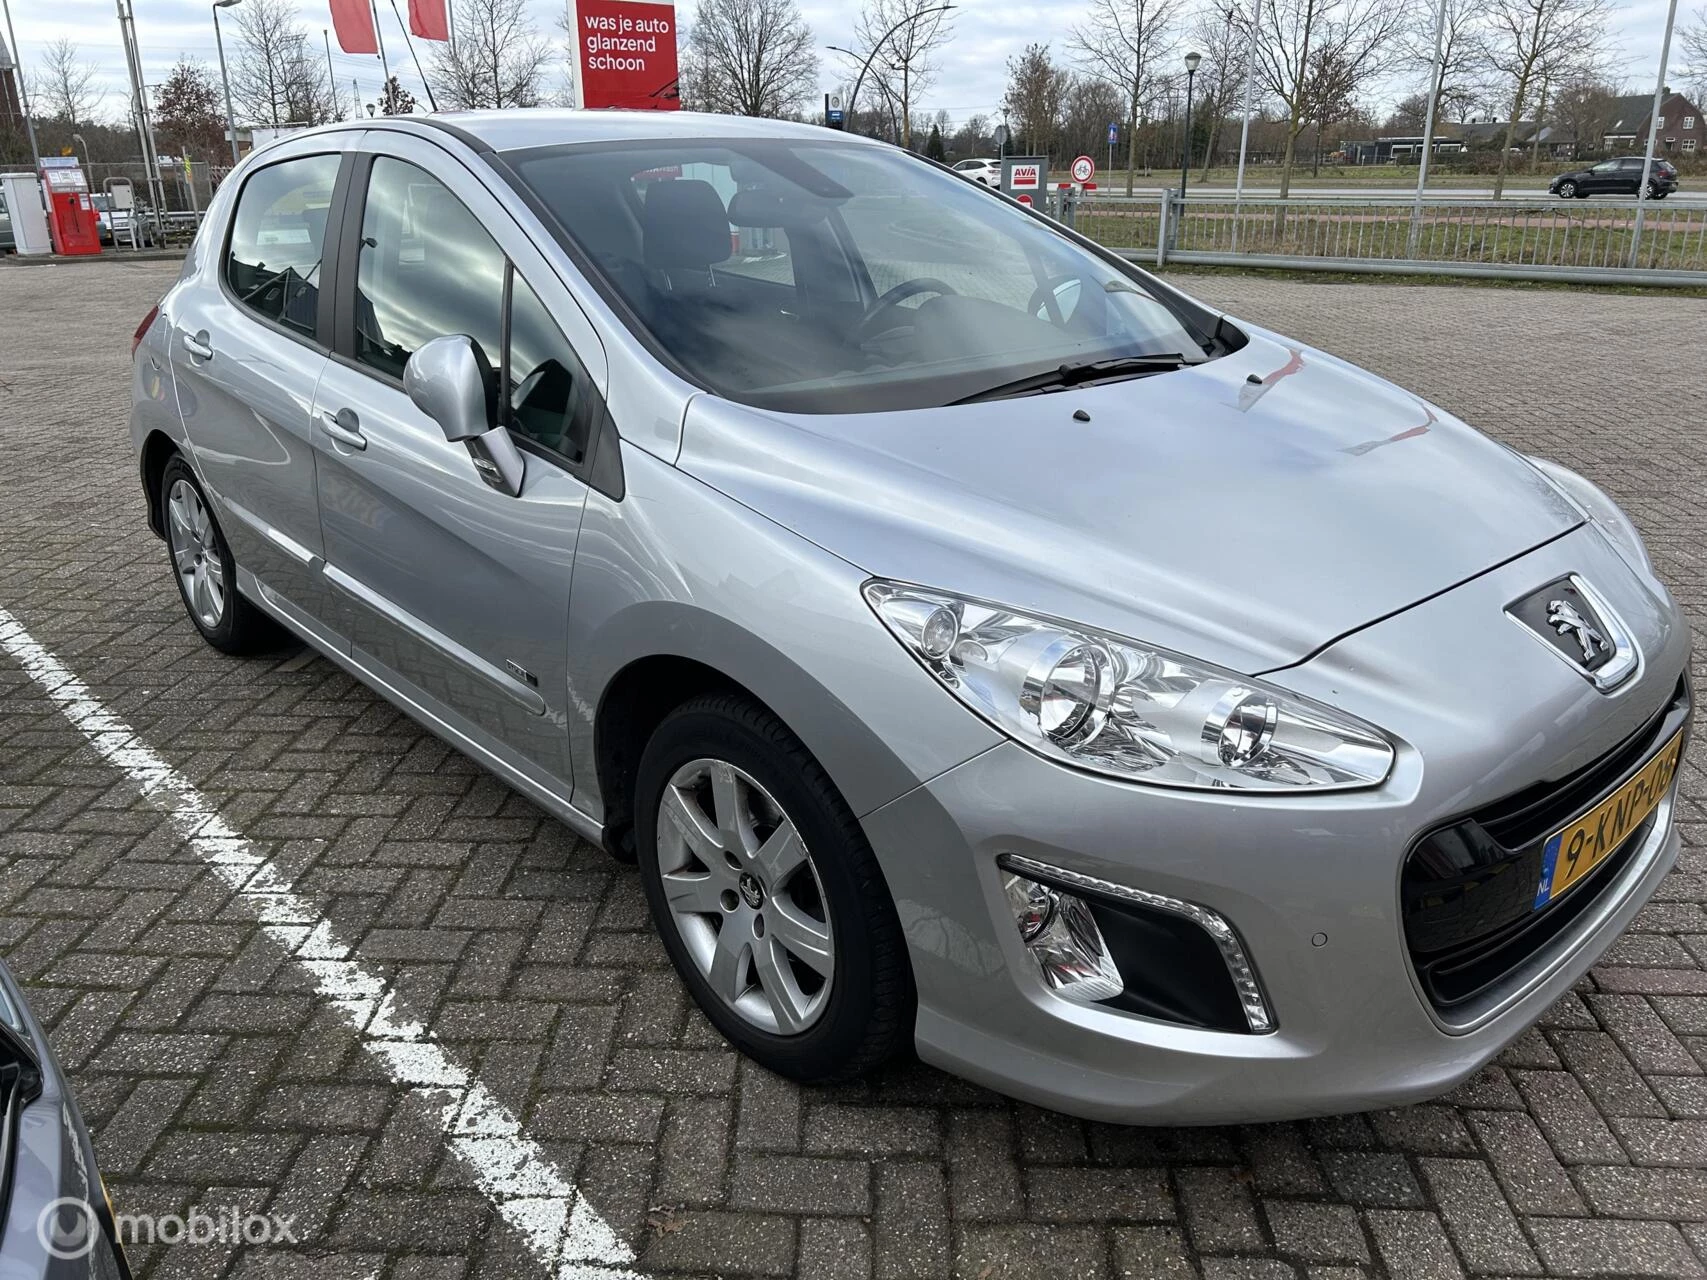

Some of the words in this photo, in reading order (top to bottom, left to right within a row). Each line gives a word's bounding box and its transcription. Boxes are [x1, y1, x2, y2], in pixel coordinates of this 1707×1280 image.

[584, 15, 617, 31] was
[618, 13, 633, 35] je
[635, 18, 669, 34] auto
[586, 32, 656, 54] glanzend
[588, 53, 646, 72] schoon
[1536, 880, 1550, 897] NL
